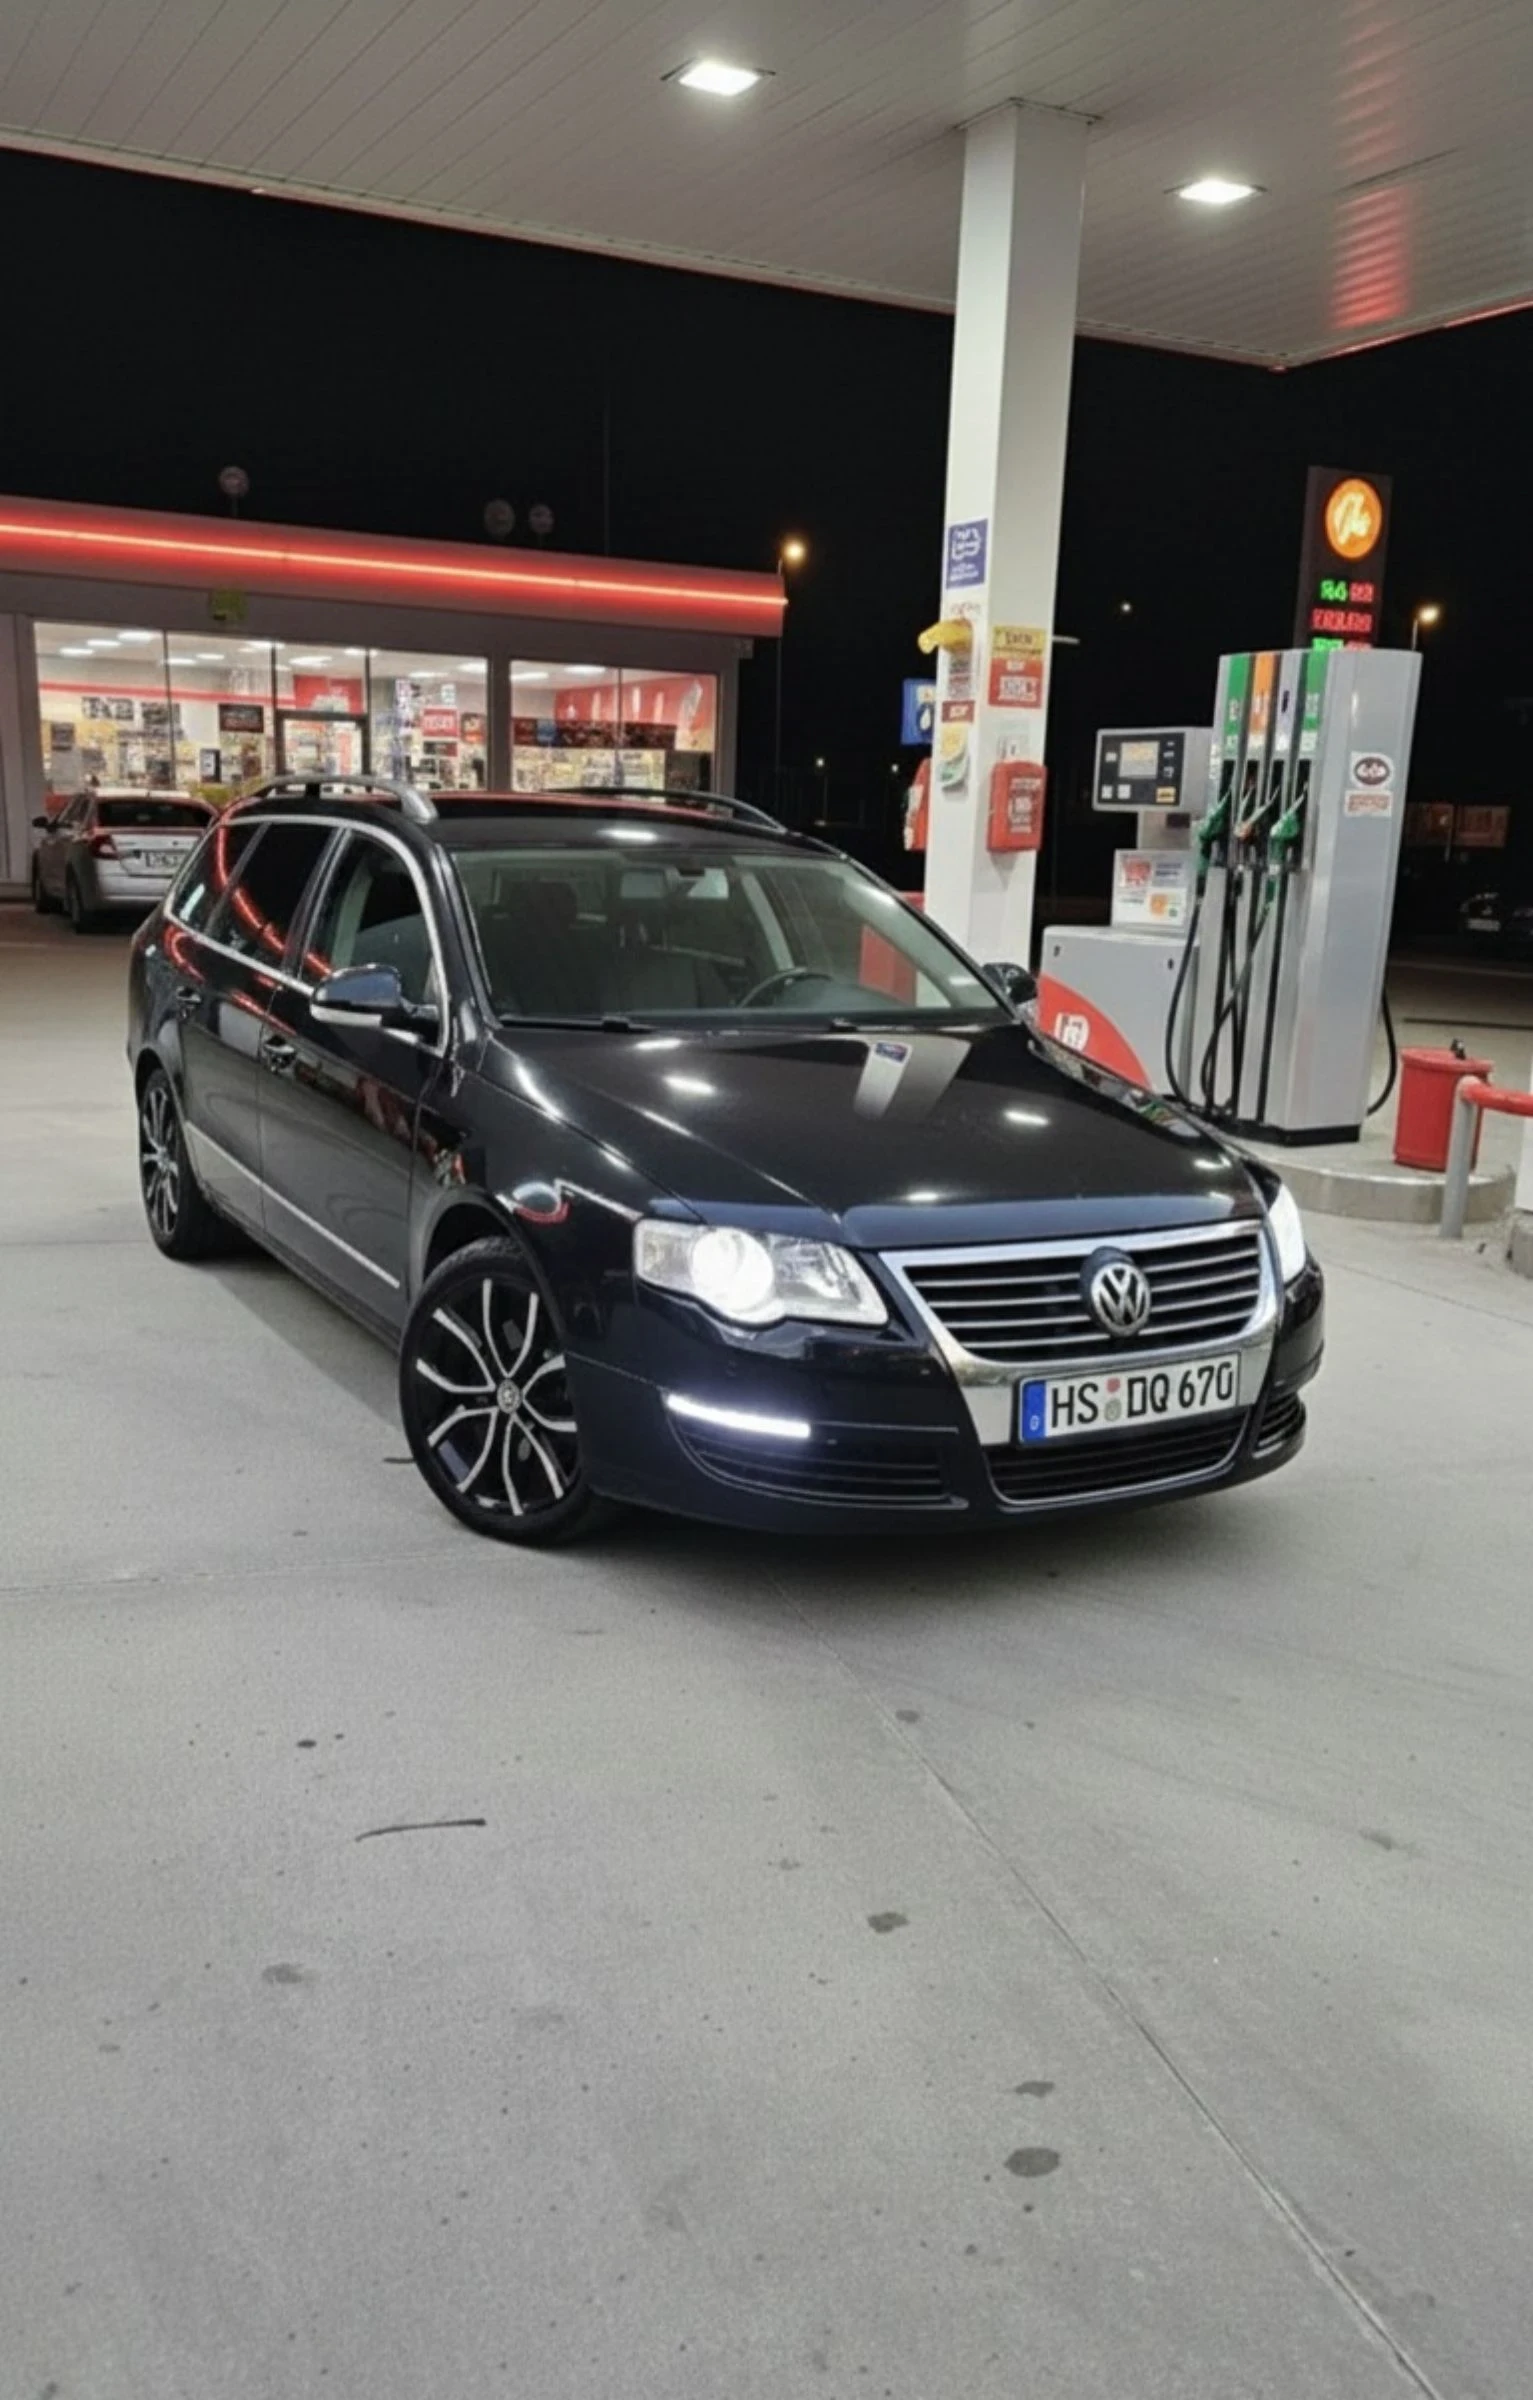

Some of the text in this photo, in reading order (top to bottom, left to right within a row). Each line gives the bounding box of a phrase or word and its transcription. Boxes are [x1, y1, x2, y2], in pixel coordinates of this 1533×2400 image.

[1051, 1361, 1234, 1429] HS DQ 670
